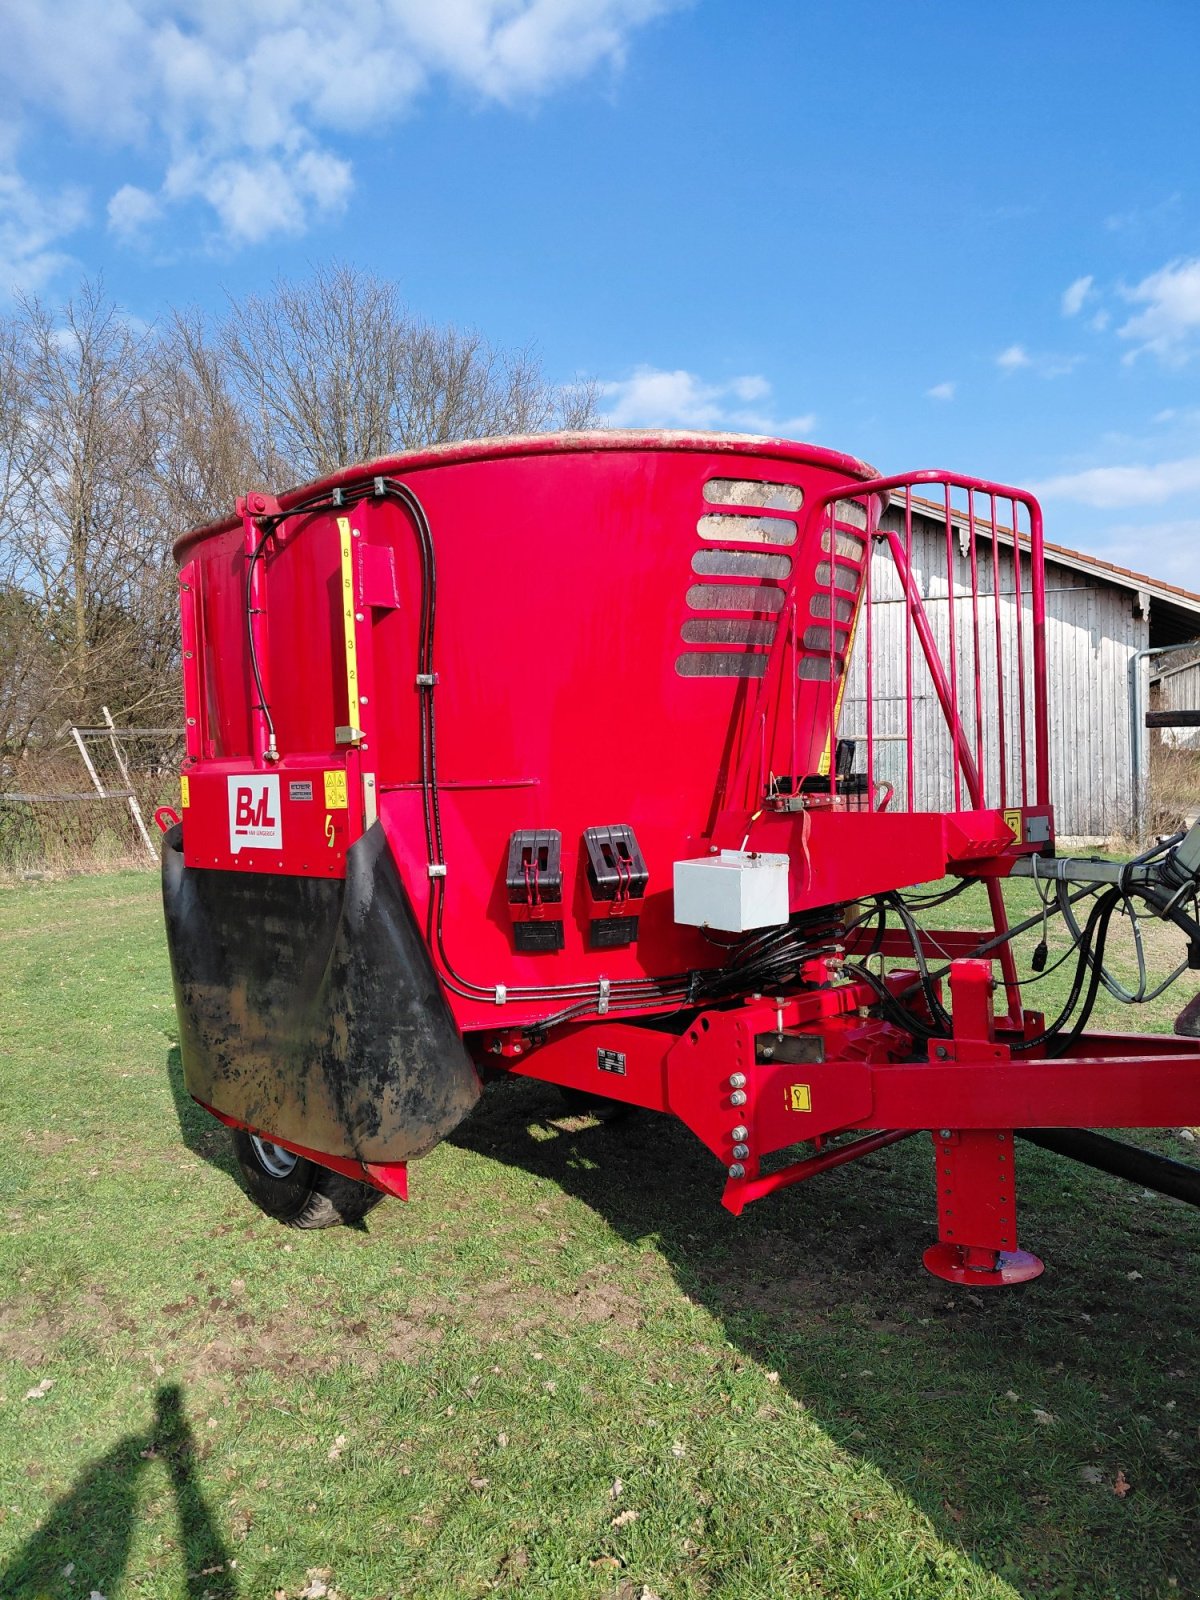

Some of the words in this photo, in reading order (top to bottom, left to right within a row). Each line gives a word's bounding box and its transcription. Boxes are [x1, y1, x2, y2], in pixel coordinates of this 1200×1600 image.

[340, 520, 346, 528] 7
[344, 548, 349, 558] 6
[345, 579, 350, 587] 5
[346, 609, 352, 618] 4
[348, 640, 354, 649] 3
[349, 670, 356, 679] 2
[351, 700, 356, 709] 1
